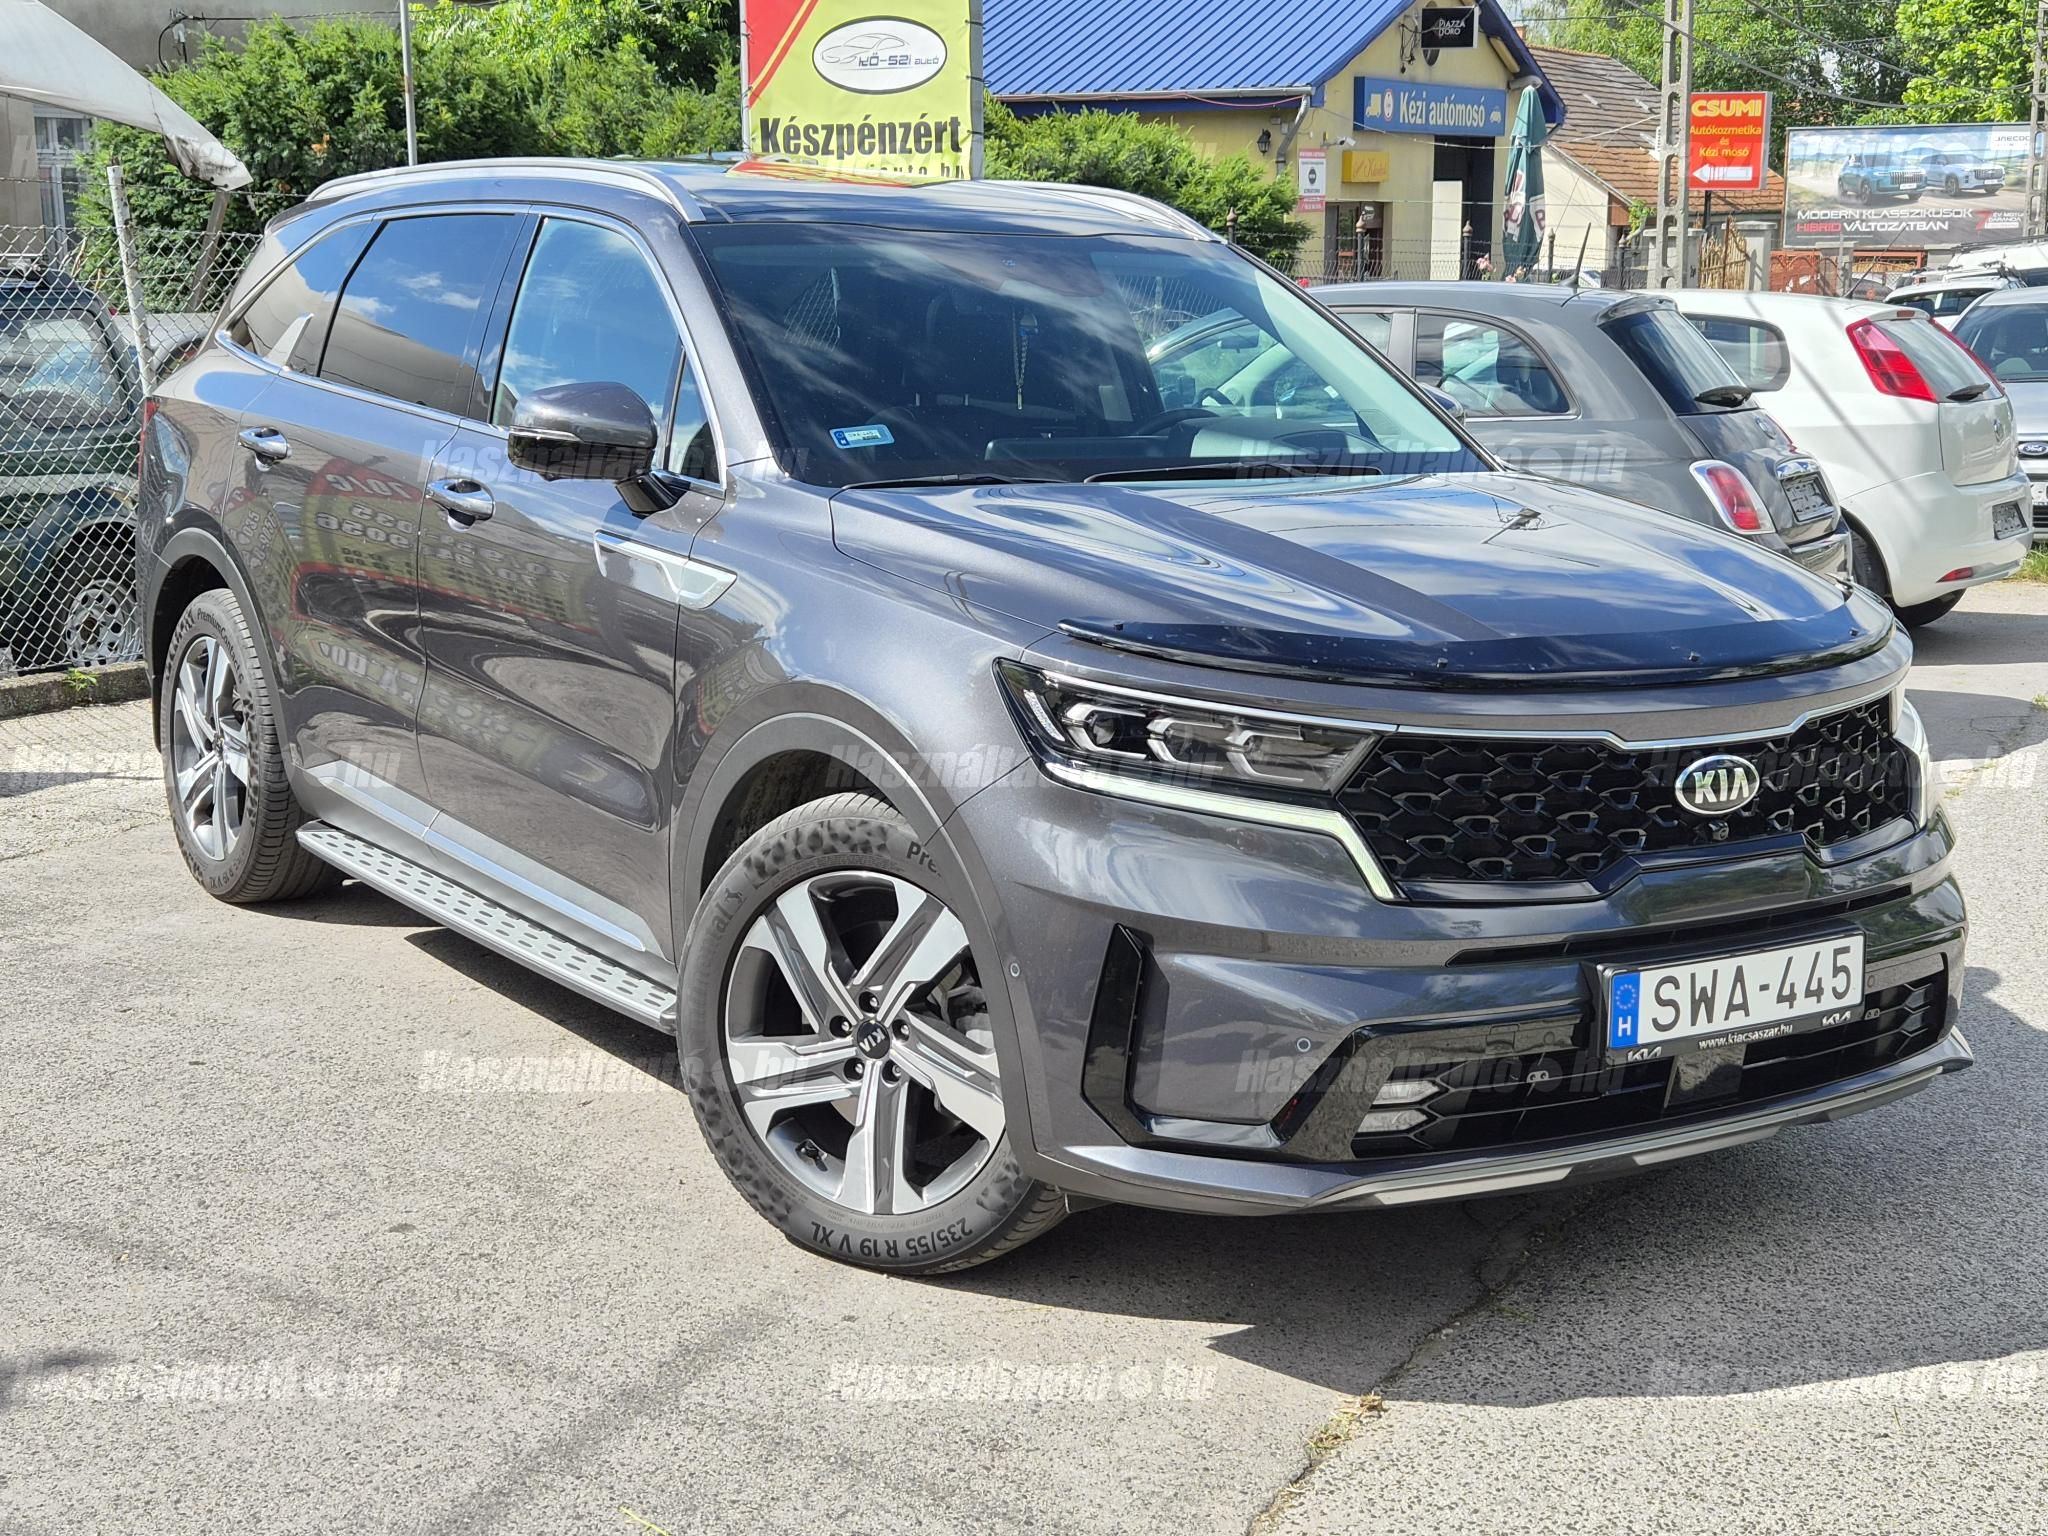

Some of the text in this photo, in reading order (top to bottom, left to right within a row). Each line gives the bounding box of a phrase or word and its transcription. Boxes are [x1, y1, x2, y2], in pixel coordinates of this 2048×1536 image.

[1400, 90, 1485, 127] Kézi autómosó
[1691, 99, 1762, 117] CSUMI
[759, 113, 963, 160] Készpénzért
[1690, 124, 1762, 135] Autókozmetika
[1699, 146, 1749, 157] Kézi mosó
[1720, 136, 1730, 146] és
[1797, 208, 1973, 220] MODERN KLASSZIKUSOK
[1796, 219, 1949, 232] HIBRID VÁLTOZATBAN
[1693, 768, 1750, 804] KIA
[1651, 945, 1851, 1033] SWA-445
[1618, 1016, 1631, 1037] H
[1698, 1023, 1793, 1050] www.kiacsaszar.hu
[860, 1027, 885, 1052] KIA
[811, 1221, 834, 1248] XL
[839, 1233, 852, 1254] V
[905, 1217, 973, 1257] 235/55
[860, 1237, 881, 1257] 19
[885, 1239, 899, 1258] R
